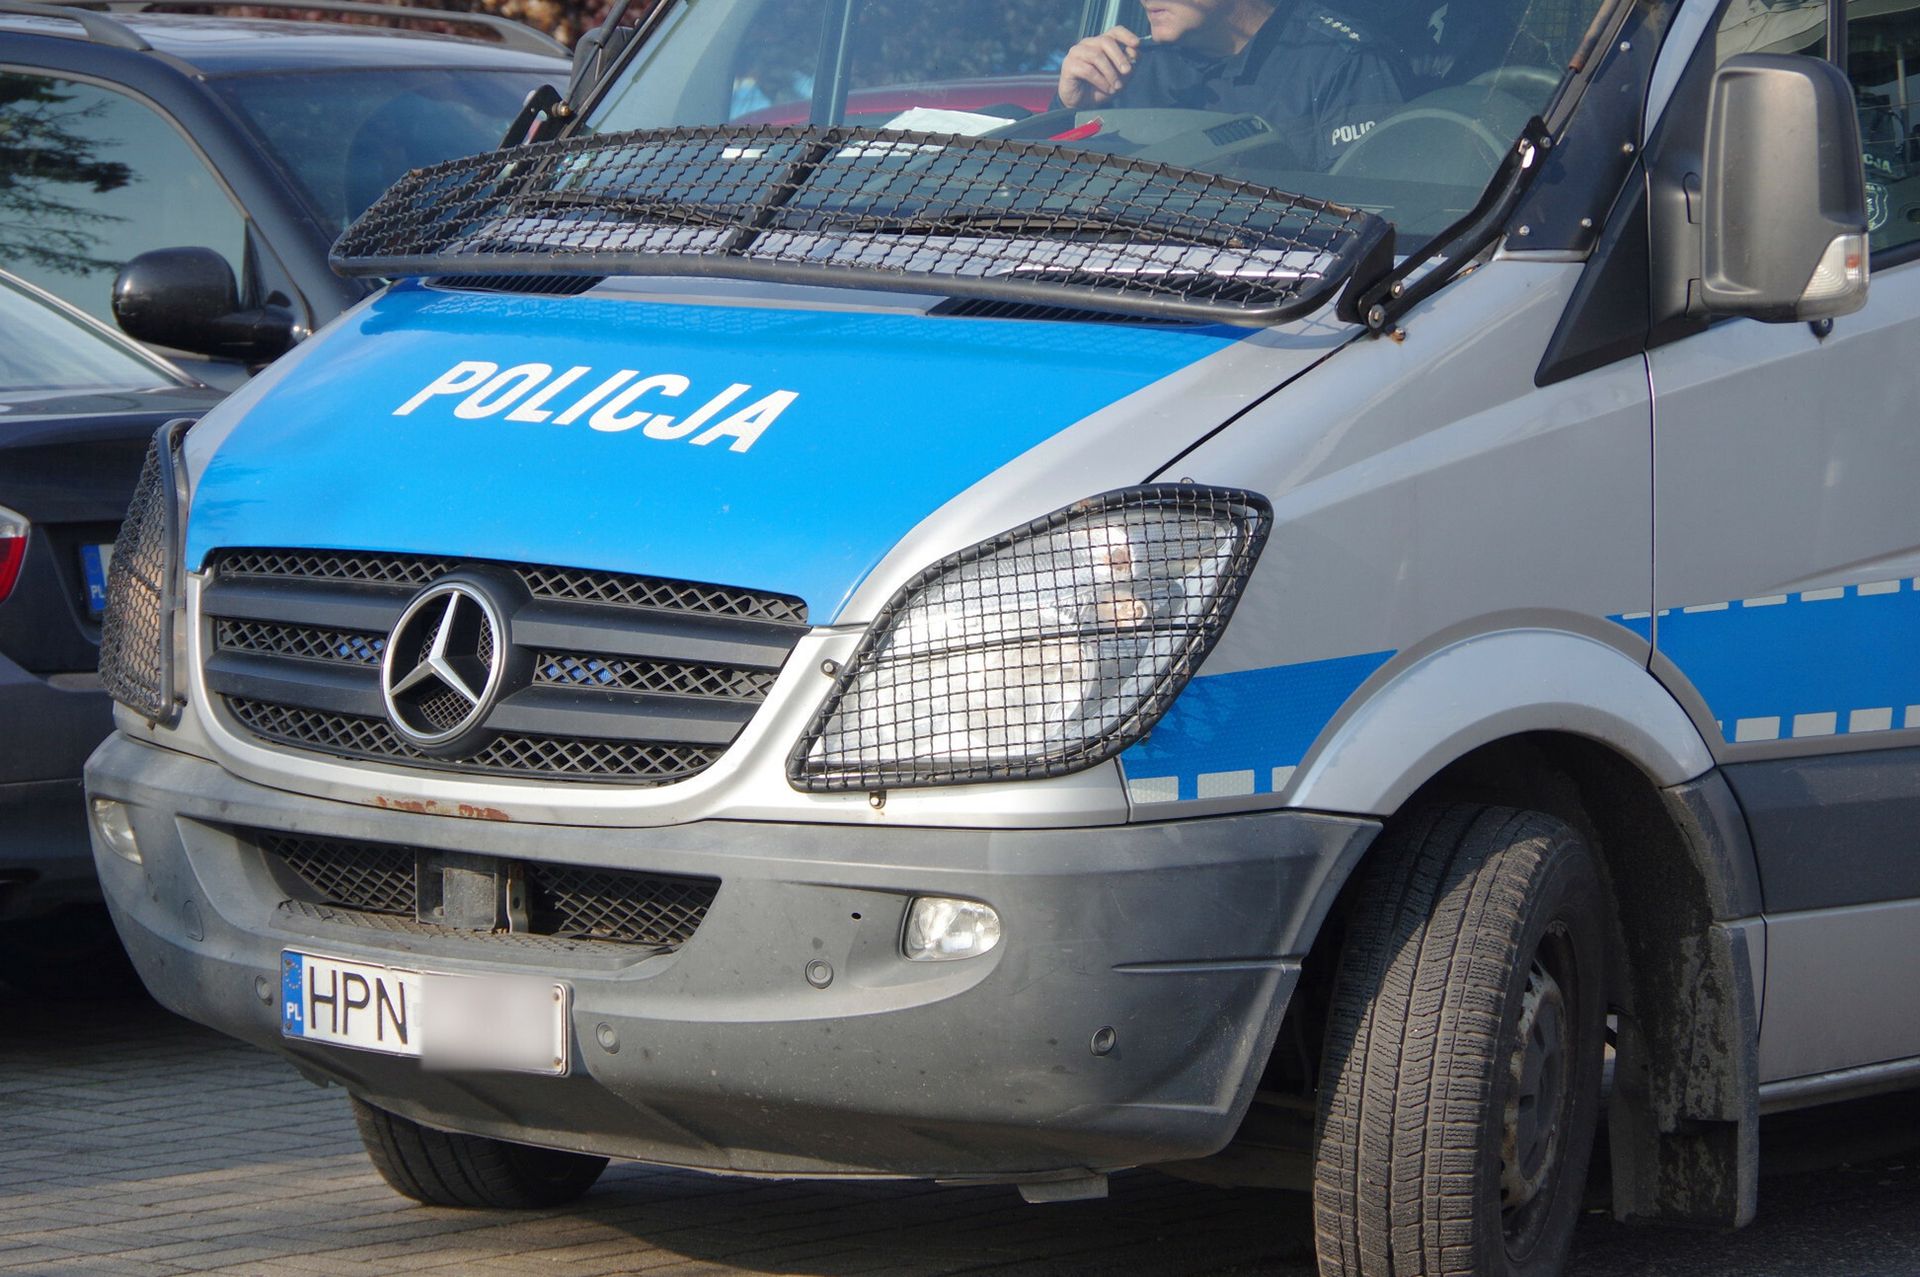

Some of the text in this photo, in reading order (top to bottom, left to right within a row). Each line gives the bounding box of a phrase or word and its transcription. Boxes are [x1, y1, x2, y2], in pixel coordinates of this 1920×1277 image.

[391, 360, 800, 454] POLICJA
[90, 584, 105, 600] PL
[286, 1001, 303, 1021] PL
[309, 965, 409, 1045] HPN
